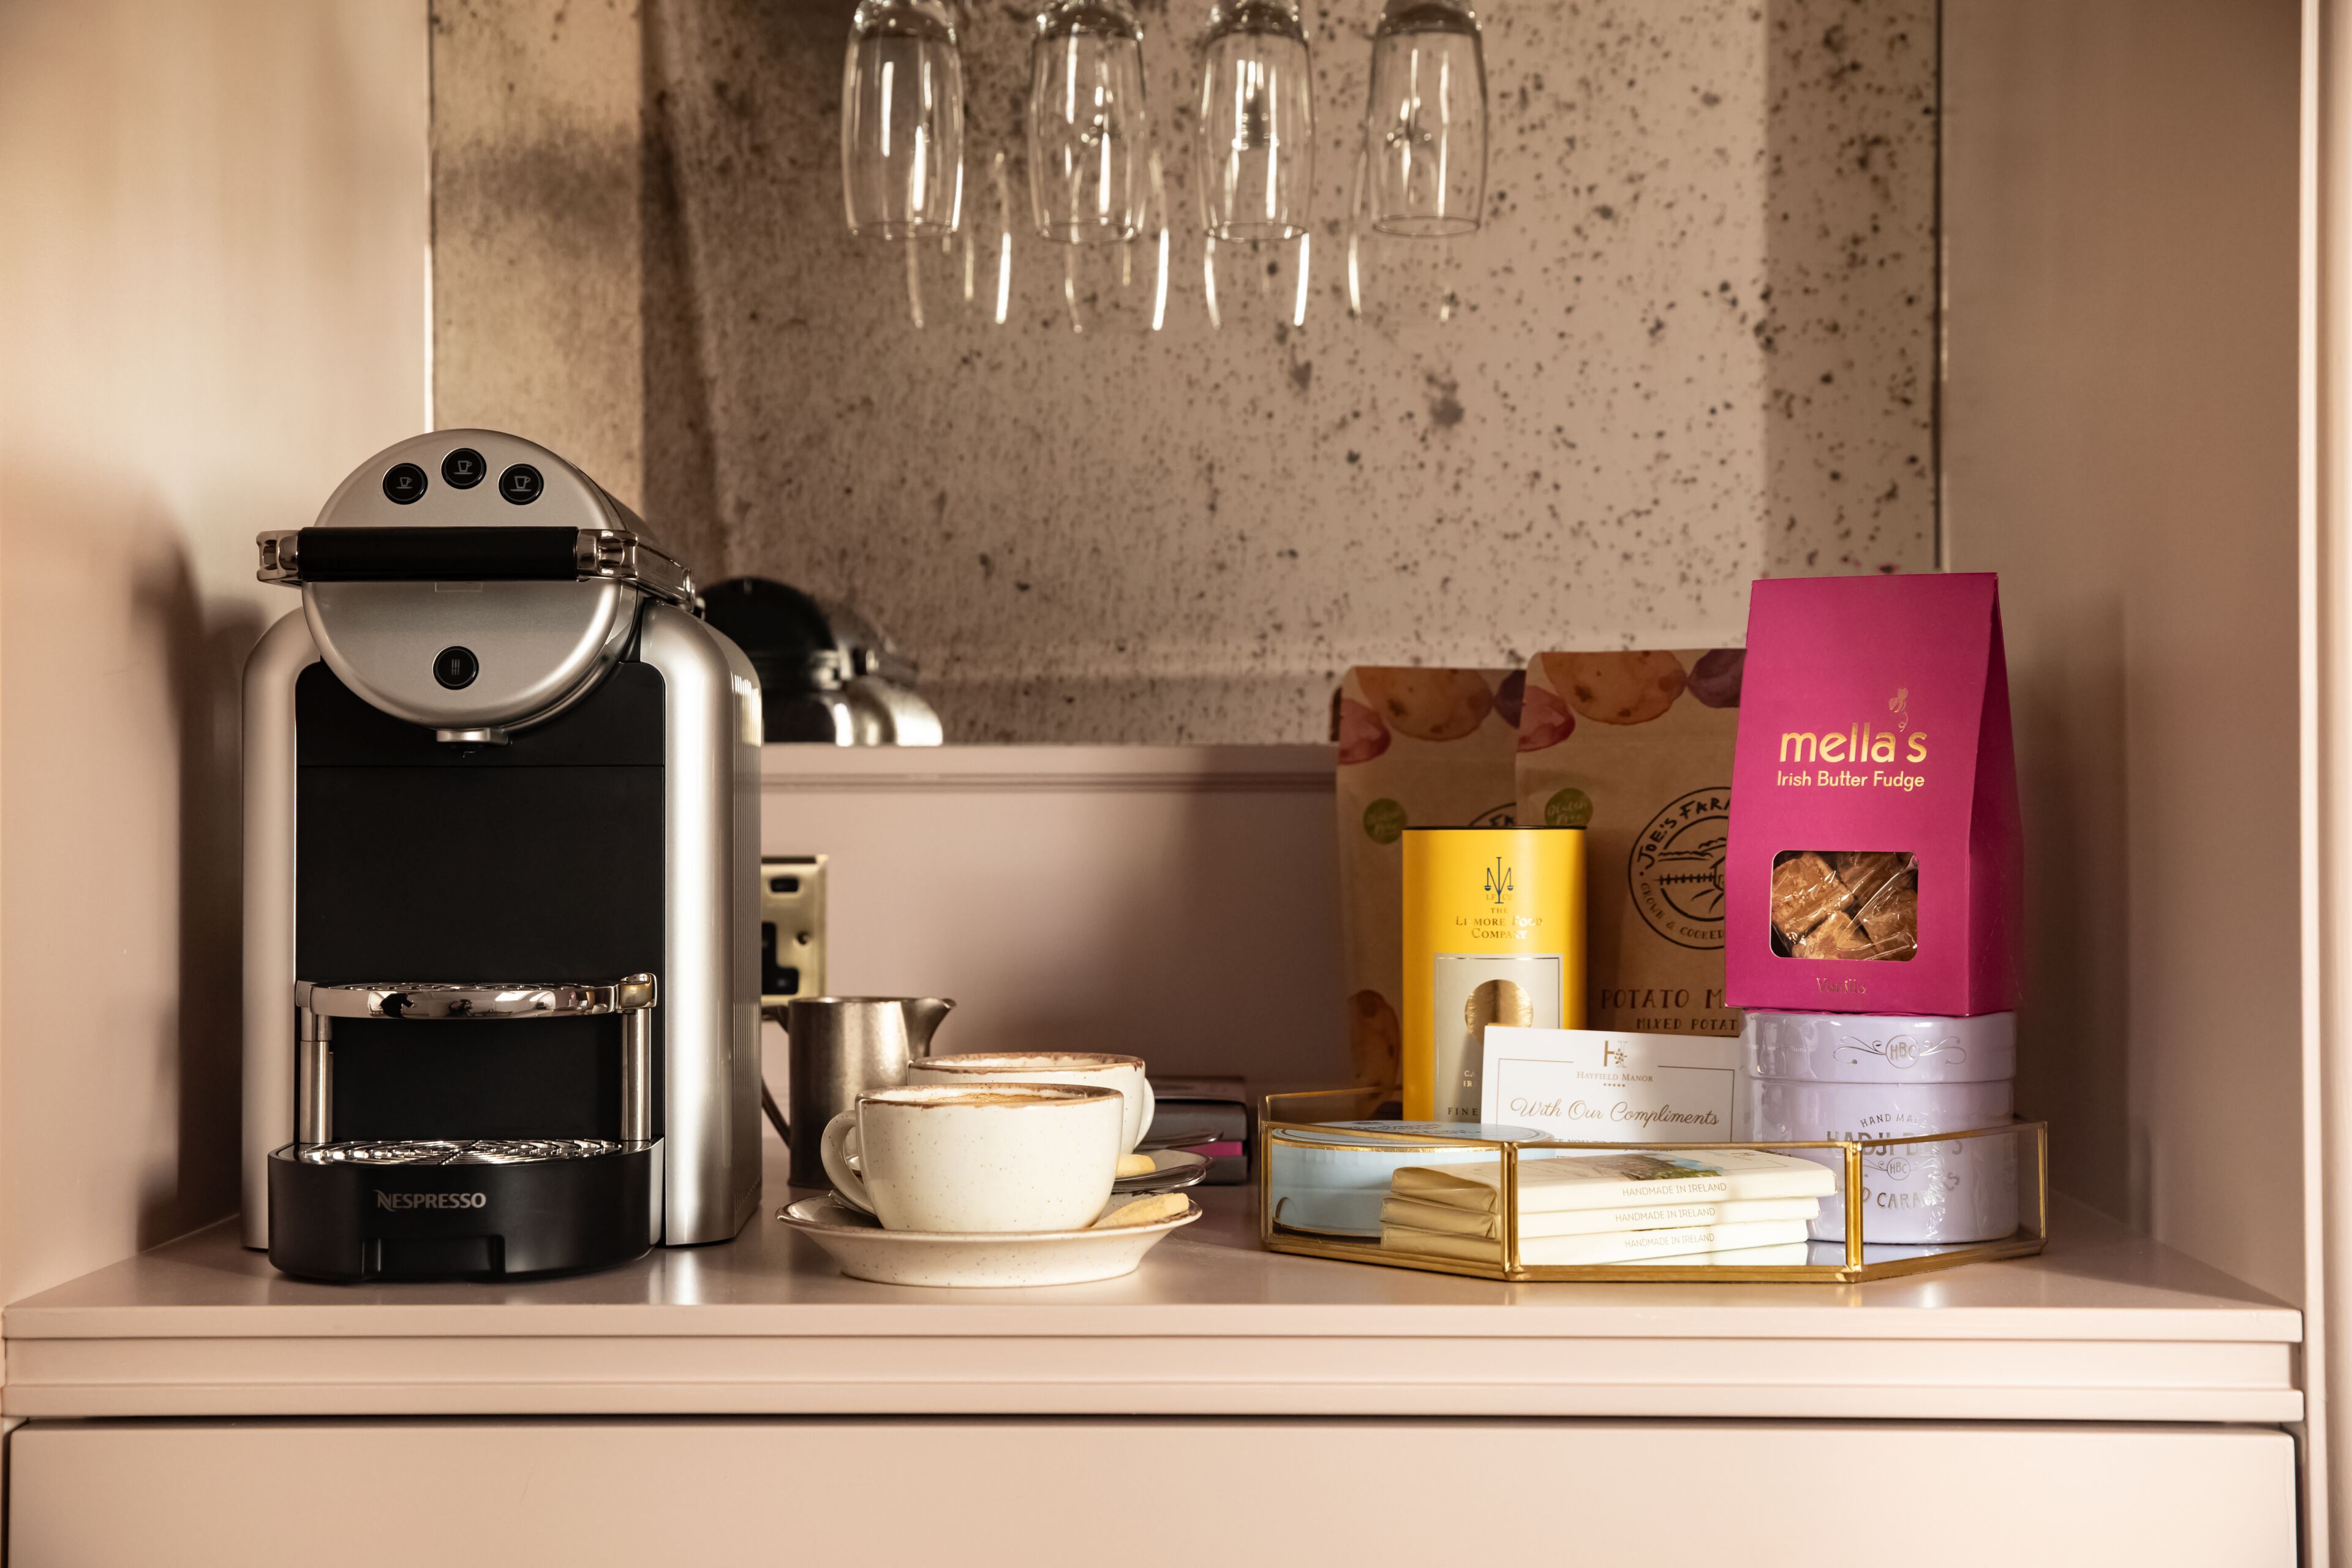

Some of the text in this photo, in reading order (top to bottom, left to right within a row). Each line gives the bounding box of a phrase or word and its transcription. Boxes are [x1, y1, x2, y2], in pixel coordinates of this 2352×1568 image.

[1777, 770, 1924, 792] Irish Butter Fudge
[1637, 797, 1731, 870] JOE'S FAR
[1455, 915, 1506, 926] LIMORE
[1679, 926, 1725, 940] COOKED
[1815, 977, 1867, 994] Vanilla
[1601, 989, 1690, 1009] POTATO
[1637, 1018, 1683, 1030] MIXED
[1576, 1071, 1653, 1082] HAYFIELD MANOR
[1447, 1107, 1479, 1116] FINE
[1510, 1097, 1720, 1128] With Our Compliments
[1860, 1114, 1891, 1128] HAND
[1889, 1162, 1908, 1175] HBC
[1623, 1182, 1727, 1196] HANDMADE IN IRELAND
[372, 1189, 487, 1212] NESPRESSO
[1615, 1207, 1716, 1222] HANDMADE IN IRELAND
[1624, 1232, 1715, 1248] HANDMADE IN IRELAND
